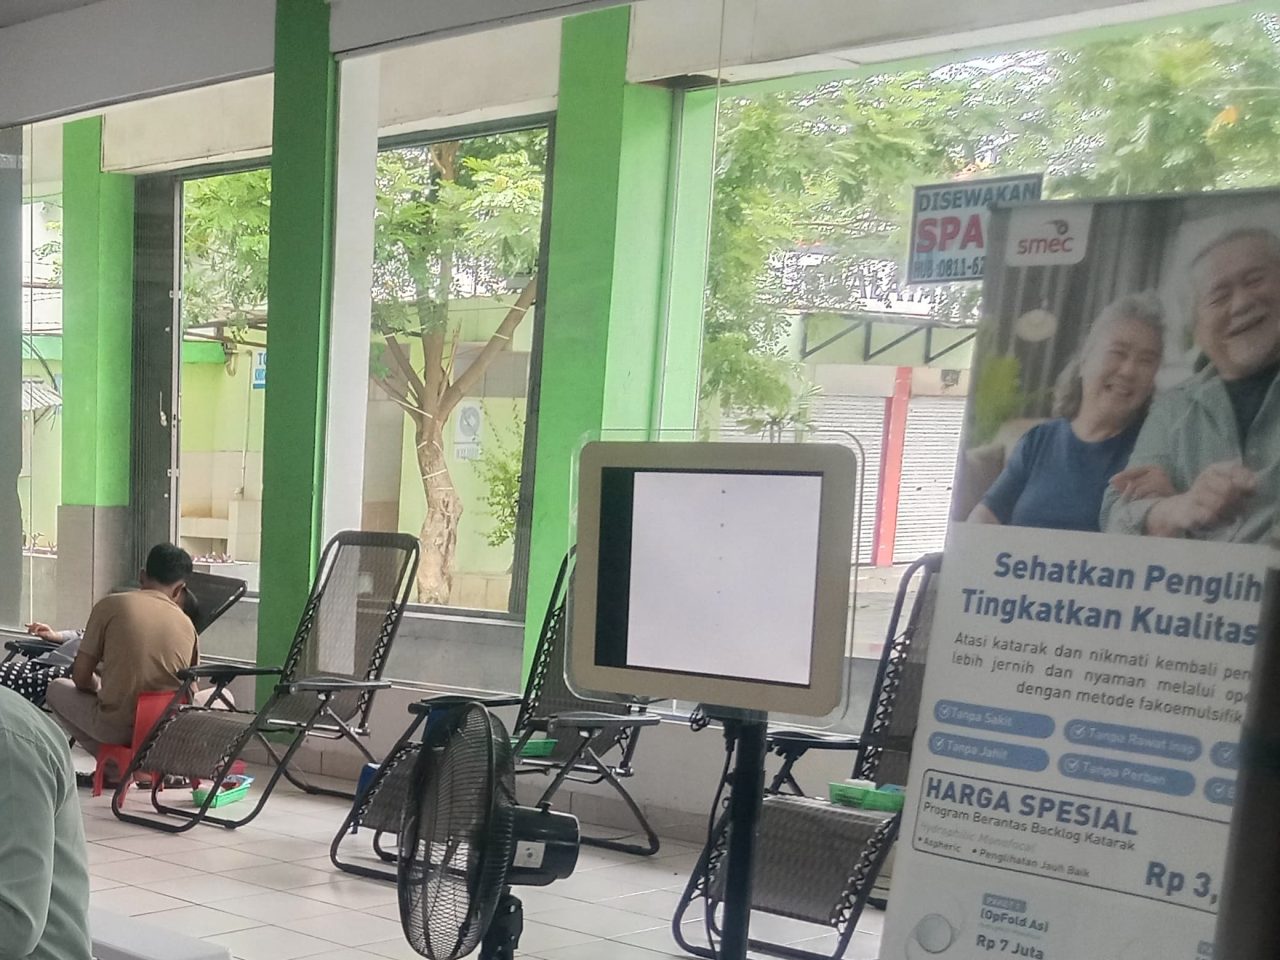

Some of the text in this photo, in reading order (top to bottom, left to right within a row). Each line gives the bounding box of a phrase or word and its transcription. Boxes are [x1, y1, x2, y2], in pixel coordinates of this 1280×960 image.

[919, 183, 1036, 211] DISEWAKAN
[916, 213, 984, 253] SPA
[1017, 237, 1074, 255] smec
[993, 552, 1263, 604] Sehatkan Penglih
[961, 587, 1259, 646] Tingkatkan Kualitas
[954, 632, 987, 647] Atasi
[992, 636, 1048, 655] katarak
[1055, 644, 1083, 659] dan
[1089, 649, 1150, 667] nikmati
[1155, 656, 1218, 676] kembali
[951, 650, 983, 667] lebih
[990, 657, 1034, 674] jernih
[1045, 664, 1073, 679] dan
[1084, 670, 1146, 689] nyaman
[1156, 678, 1216, 698] melalui
[951, 706, 1013, 727] Tanpa Sakit
[1016, 681, 1243, 723] dengan metode fakoemulsifik
[947, 740, 978, 756] Tanpa
[1089, 727, 1126, 744] Tanpa
[1128, 734, 1166, 749] Rawat
[1083, 761, 1166, 785] Tanpa Perban
[925, 777, 1138, 836] HARGA SPESIAL
[923, 801, 1136, 851] Program Berantas Backlog Katarak
[978, 848, 1039, 867] Penglihatan
[1040, 860, 1065, 874] Jauh
[1067, 865, 1091, 878] Baik
[1145, 861, 1185, 896] Rp
[976, 934, 1045, 960] Rp 7 Juta
